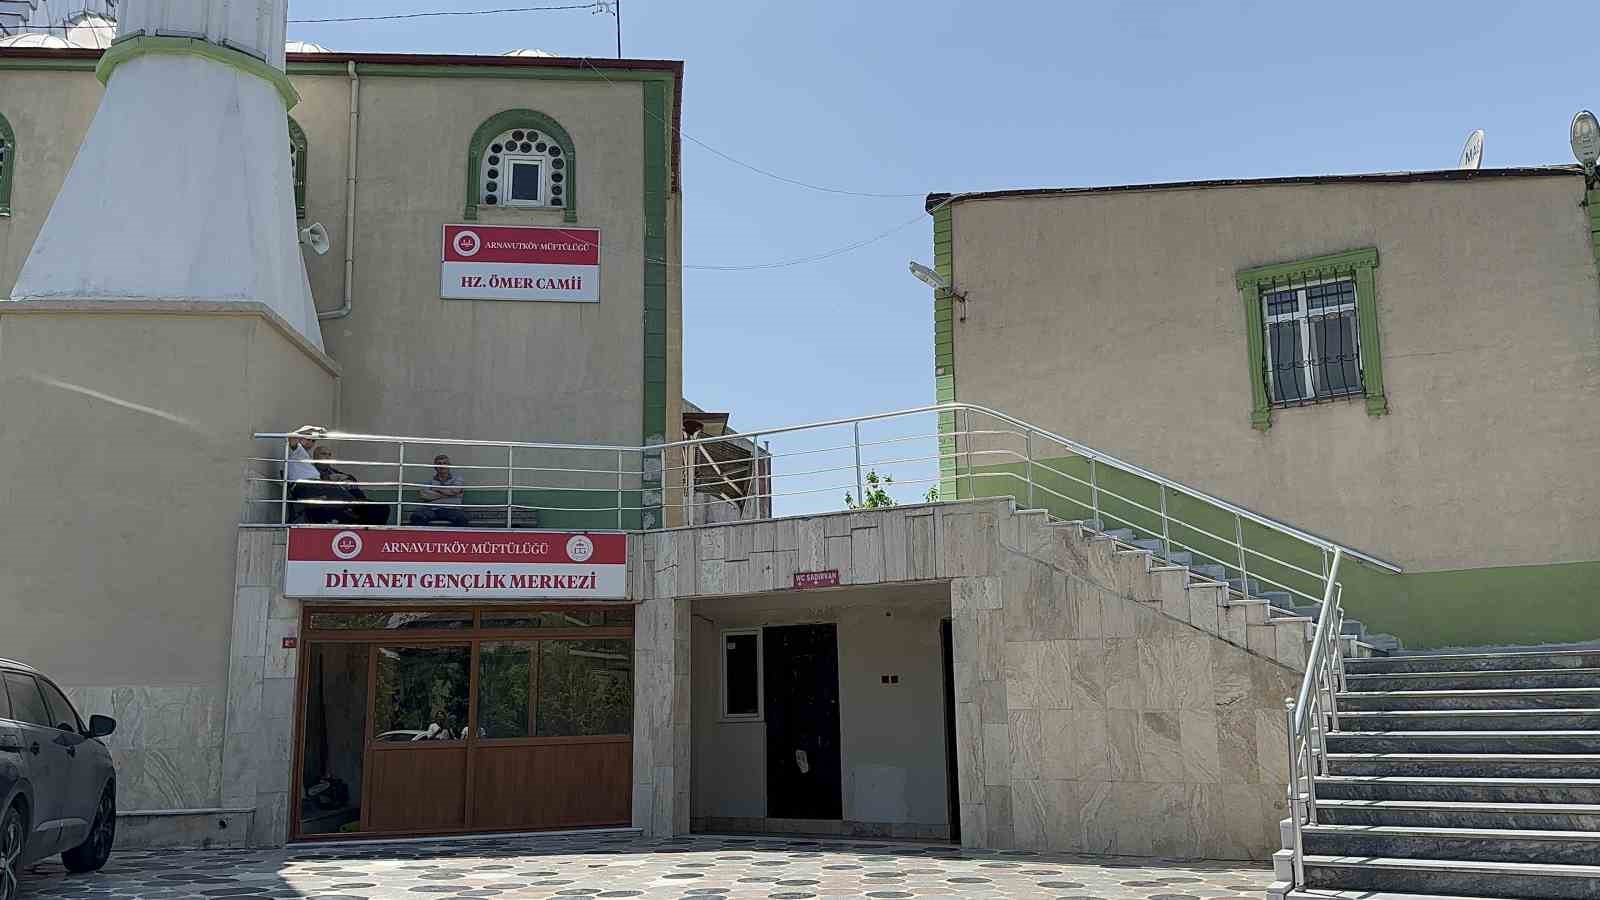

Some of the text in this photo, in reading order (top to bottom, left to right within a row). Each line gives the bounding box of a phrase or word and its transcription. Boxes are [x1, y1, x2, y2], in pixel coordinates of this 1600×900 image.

[485, 241, 590, 251] ARNAVUTKÖY MÜFTÜLÜĞÜ
[461, 274, 582, 290] HZ. ÖMER CAMİİ
[381, 541, 549, 554] ARNAVUTKÖY MÜFTÜLÜĞÜ
[325, 569, 597, 592] DİYANET GENÇLİK MERKEZİ
